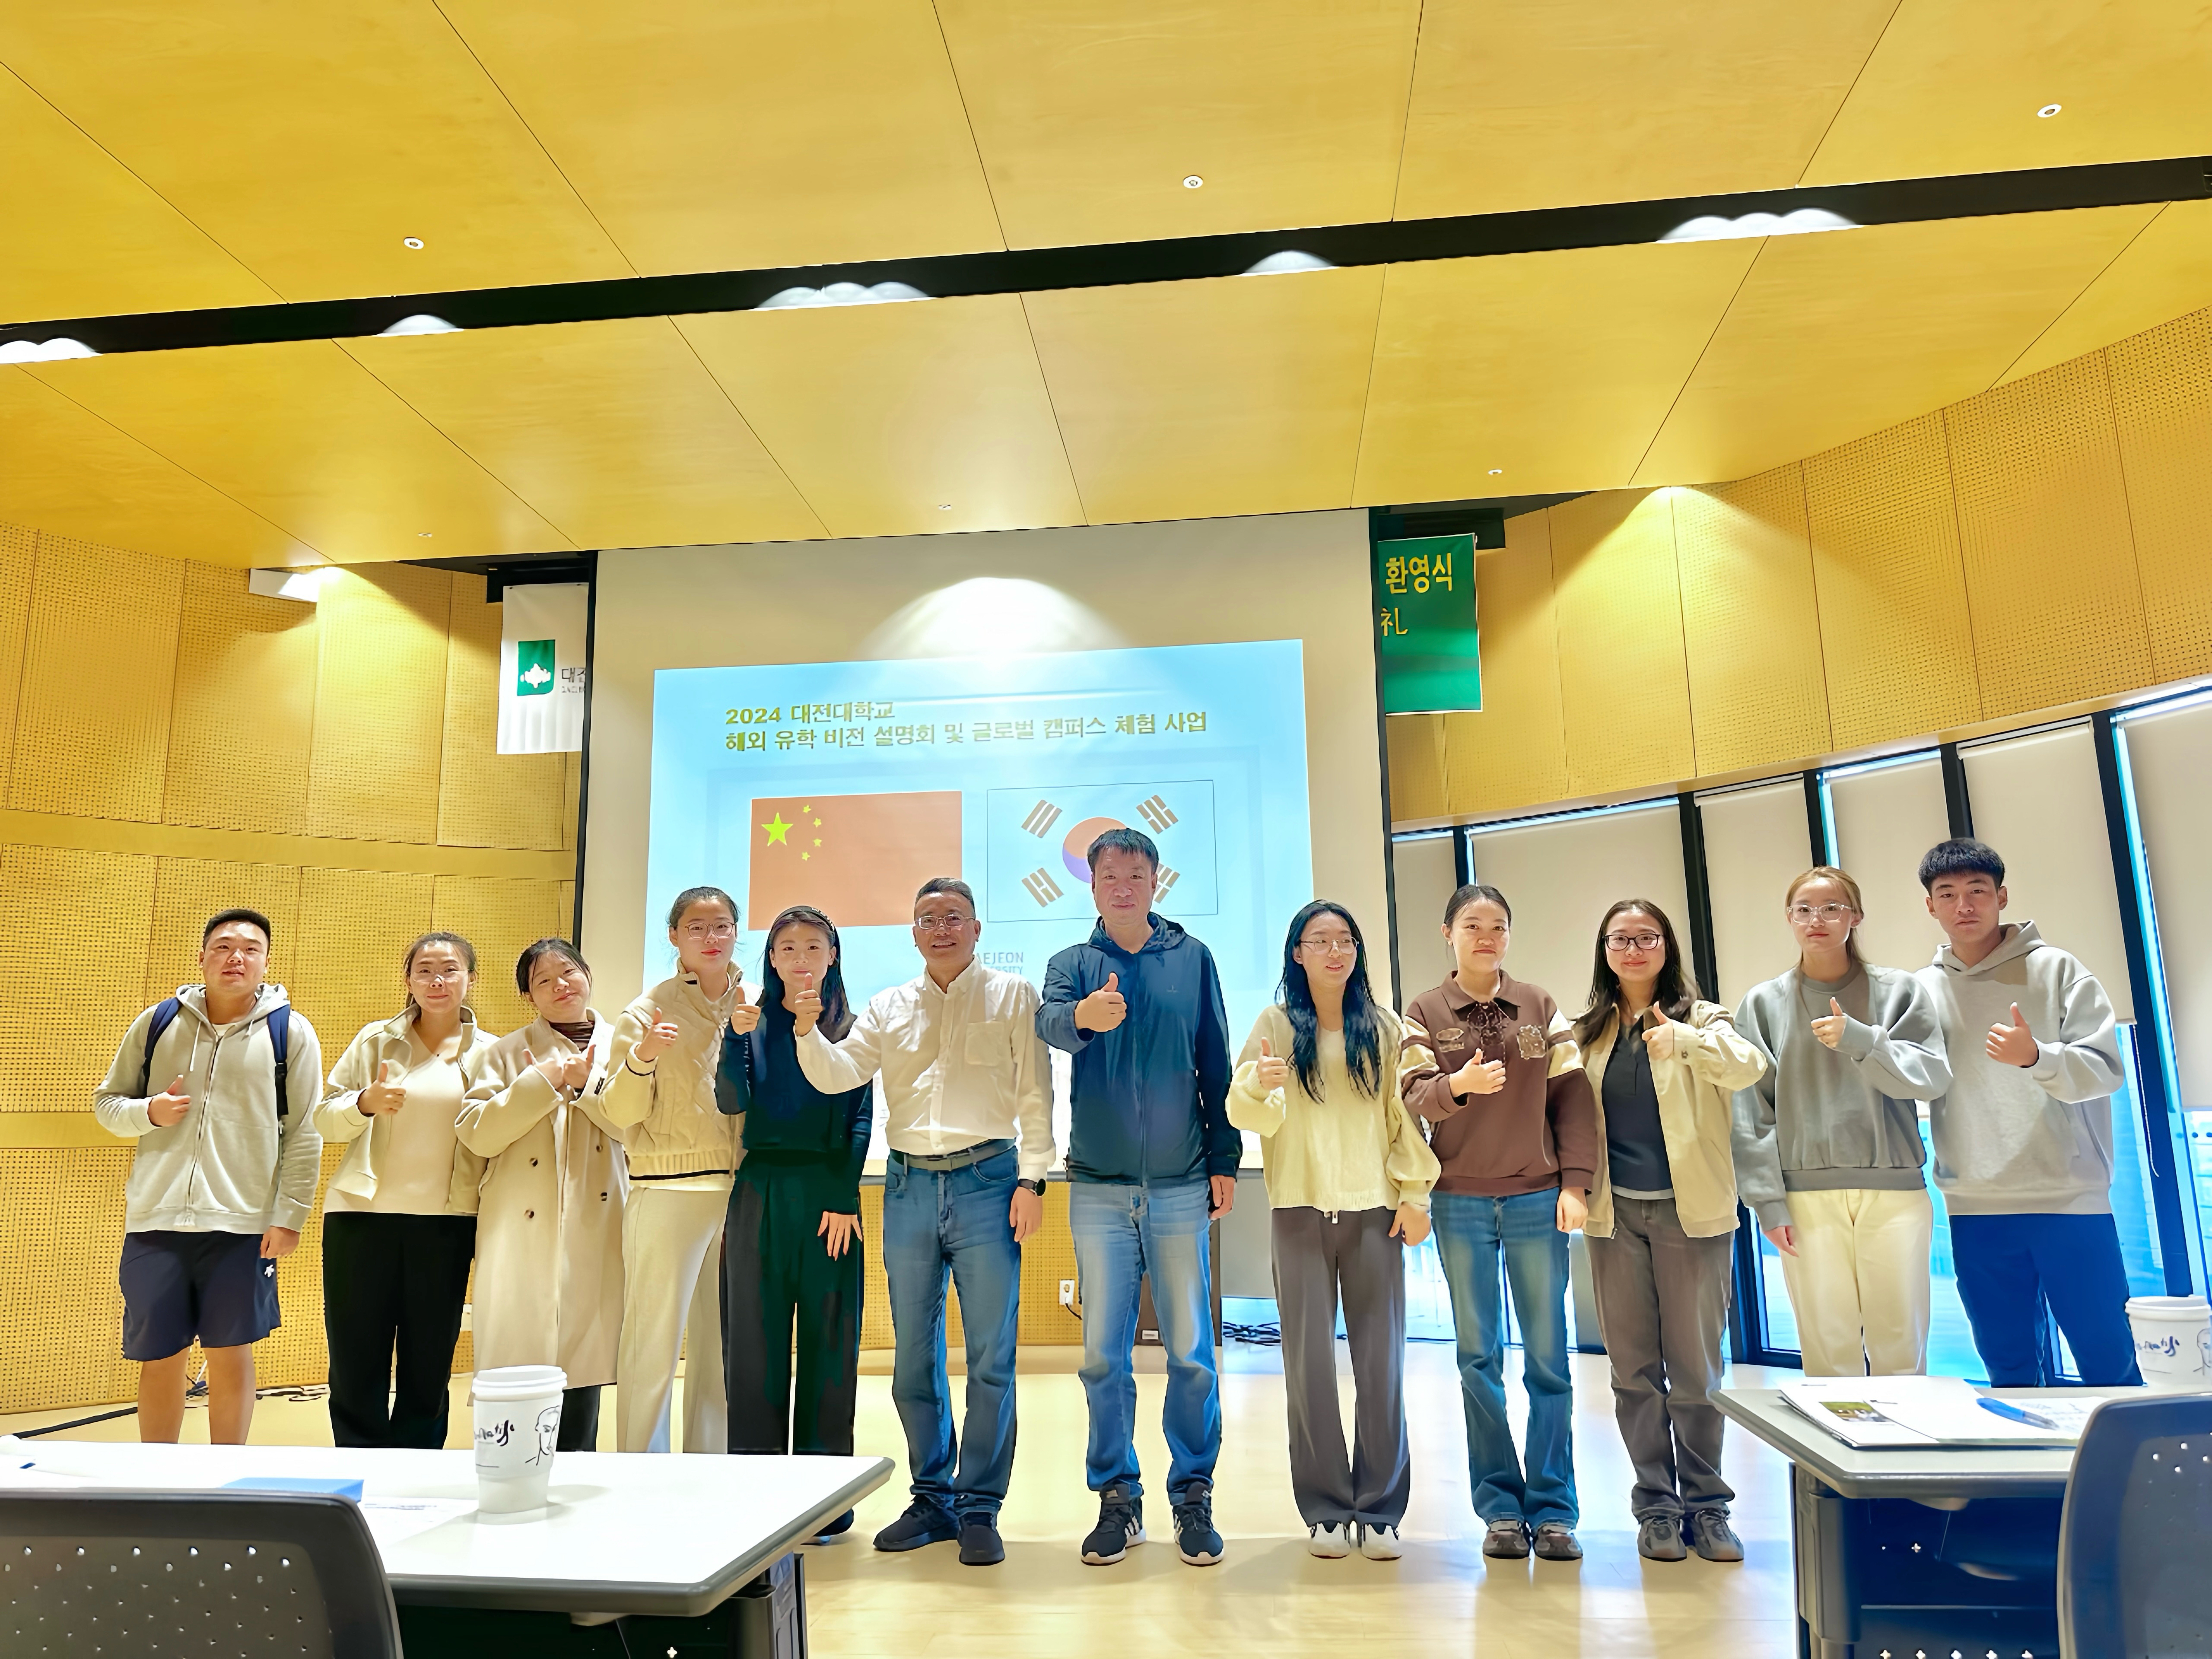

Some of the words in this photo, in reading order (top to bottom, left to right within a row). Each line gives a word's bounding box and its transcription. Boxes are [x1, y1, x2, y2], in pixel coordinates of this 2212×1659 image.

[1386, 553, 1452, 594] 환영식
[726, 708, 781, 724] 2024
[791, 702, 895, 723] 대전대학교
[726, 731, 765, 751] 해외
[775, 729, 817, 750] 유학
[825, 727, 864, 748] 비전
[874, 724, 934, 746] 설명회
[944, 723, 963, 744] 및
[972, 719, 1034, 741] 글로벌
[1043, 717, 1106, 739] 캠퍼스
[1115, 714, 1155, 734] 체험
[1165, 712, 1206, 732] 사업
[976, 952, 1023, 965] AEJEON
